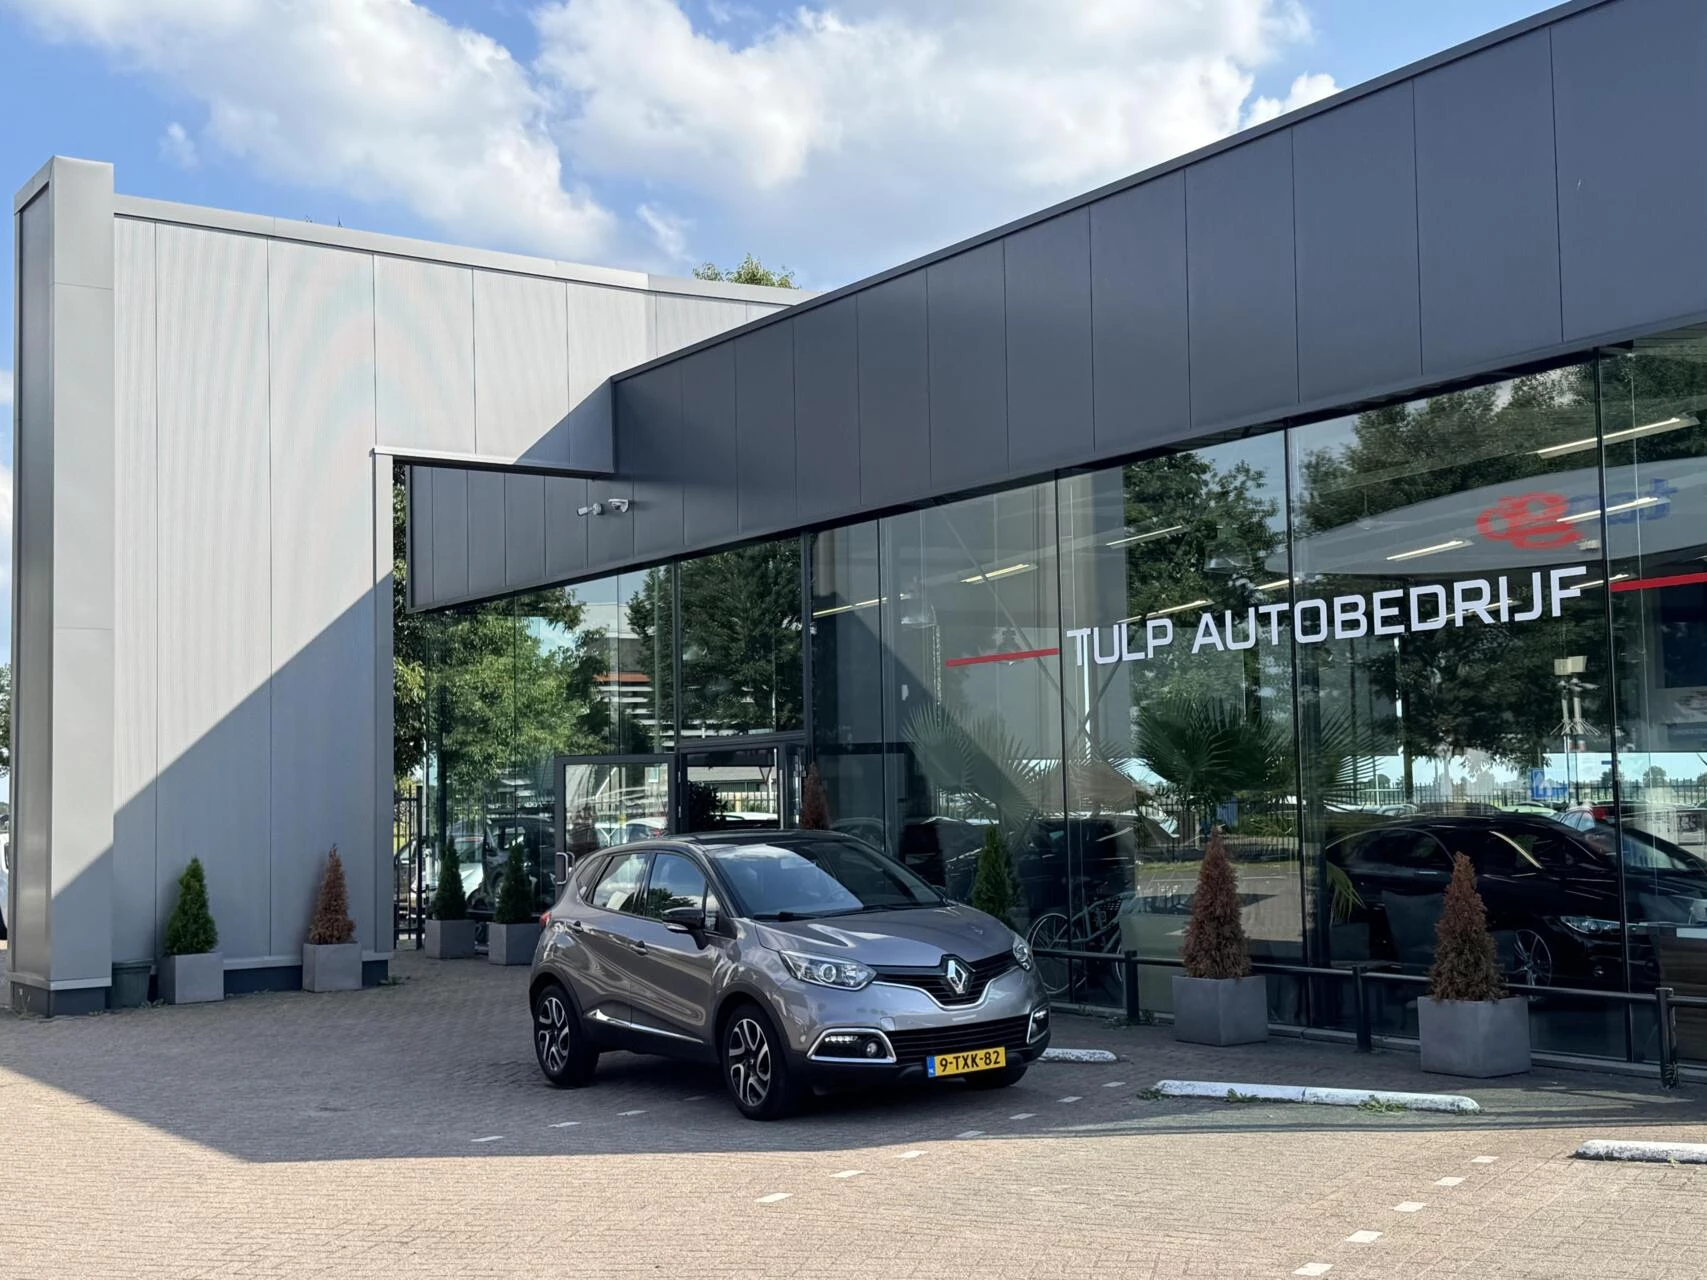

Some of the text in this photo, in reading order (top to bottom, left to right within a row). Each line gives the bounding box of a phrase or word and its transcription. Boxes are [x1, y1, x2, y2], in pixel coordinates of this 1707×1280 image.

[1067, 566, 1587, 666] TULP AUTOBEDRIJF
[939, 1050, 1001, 1073] 9-TXK-82
